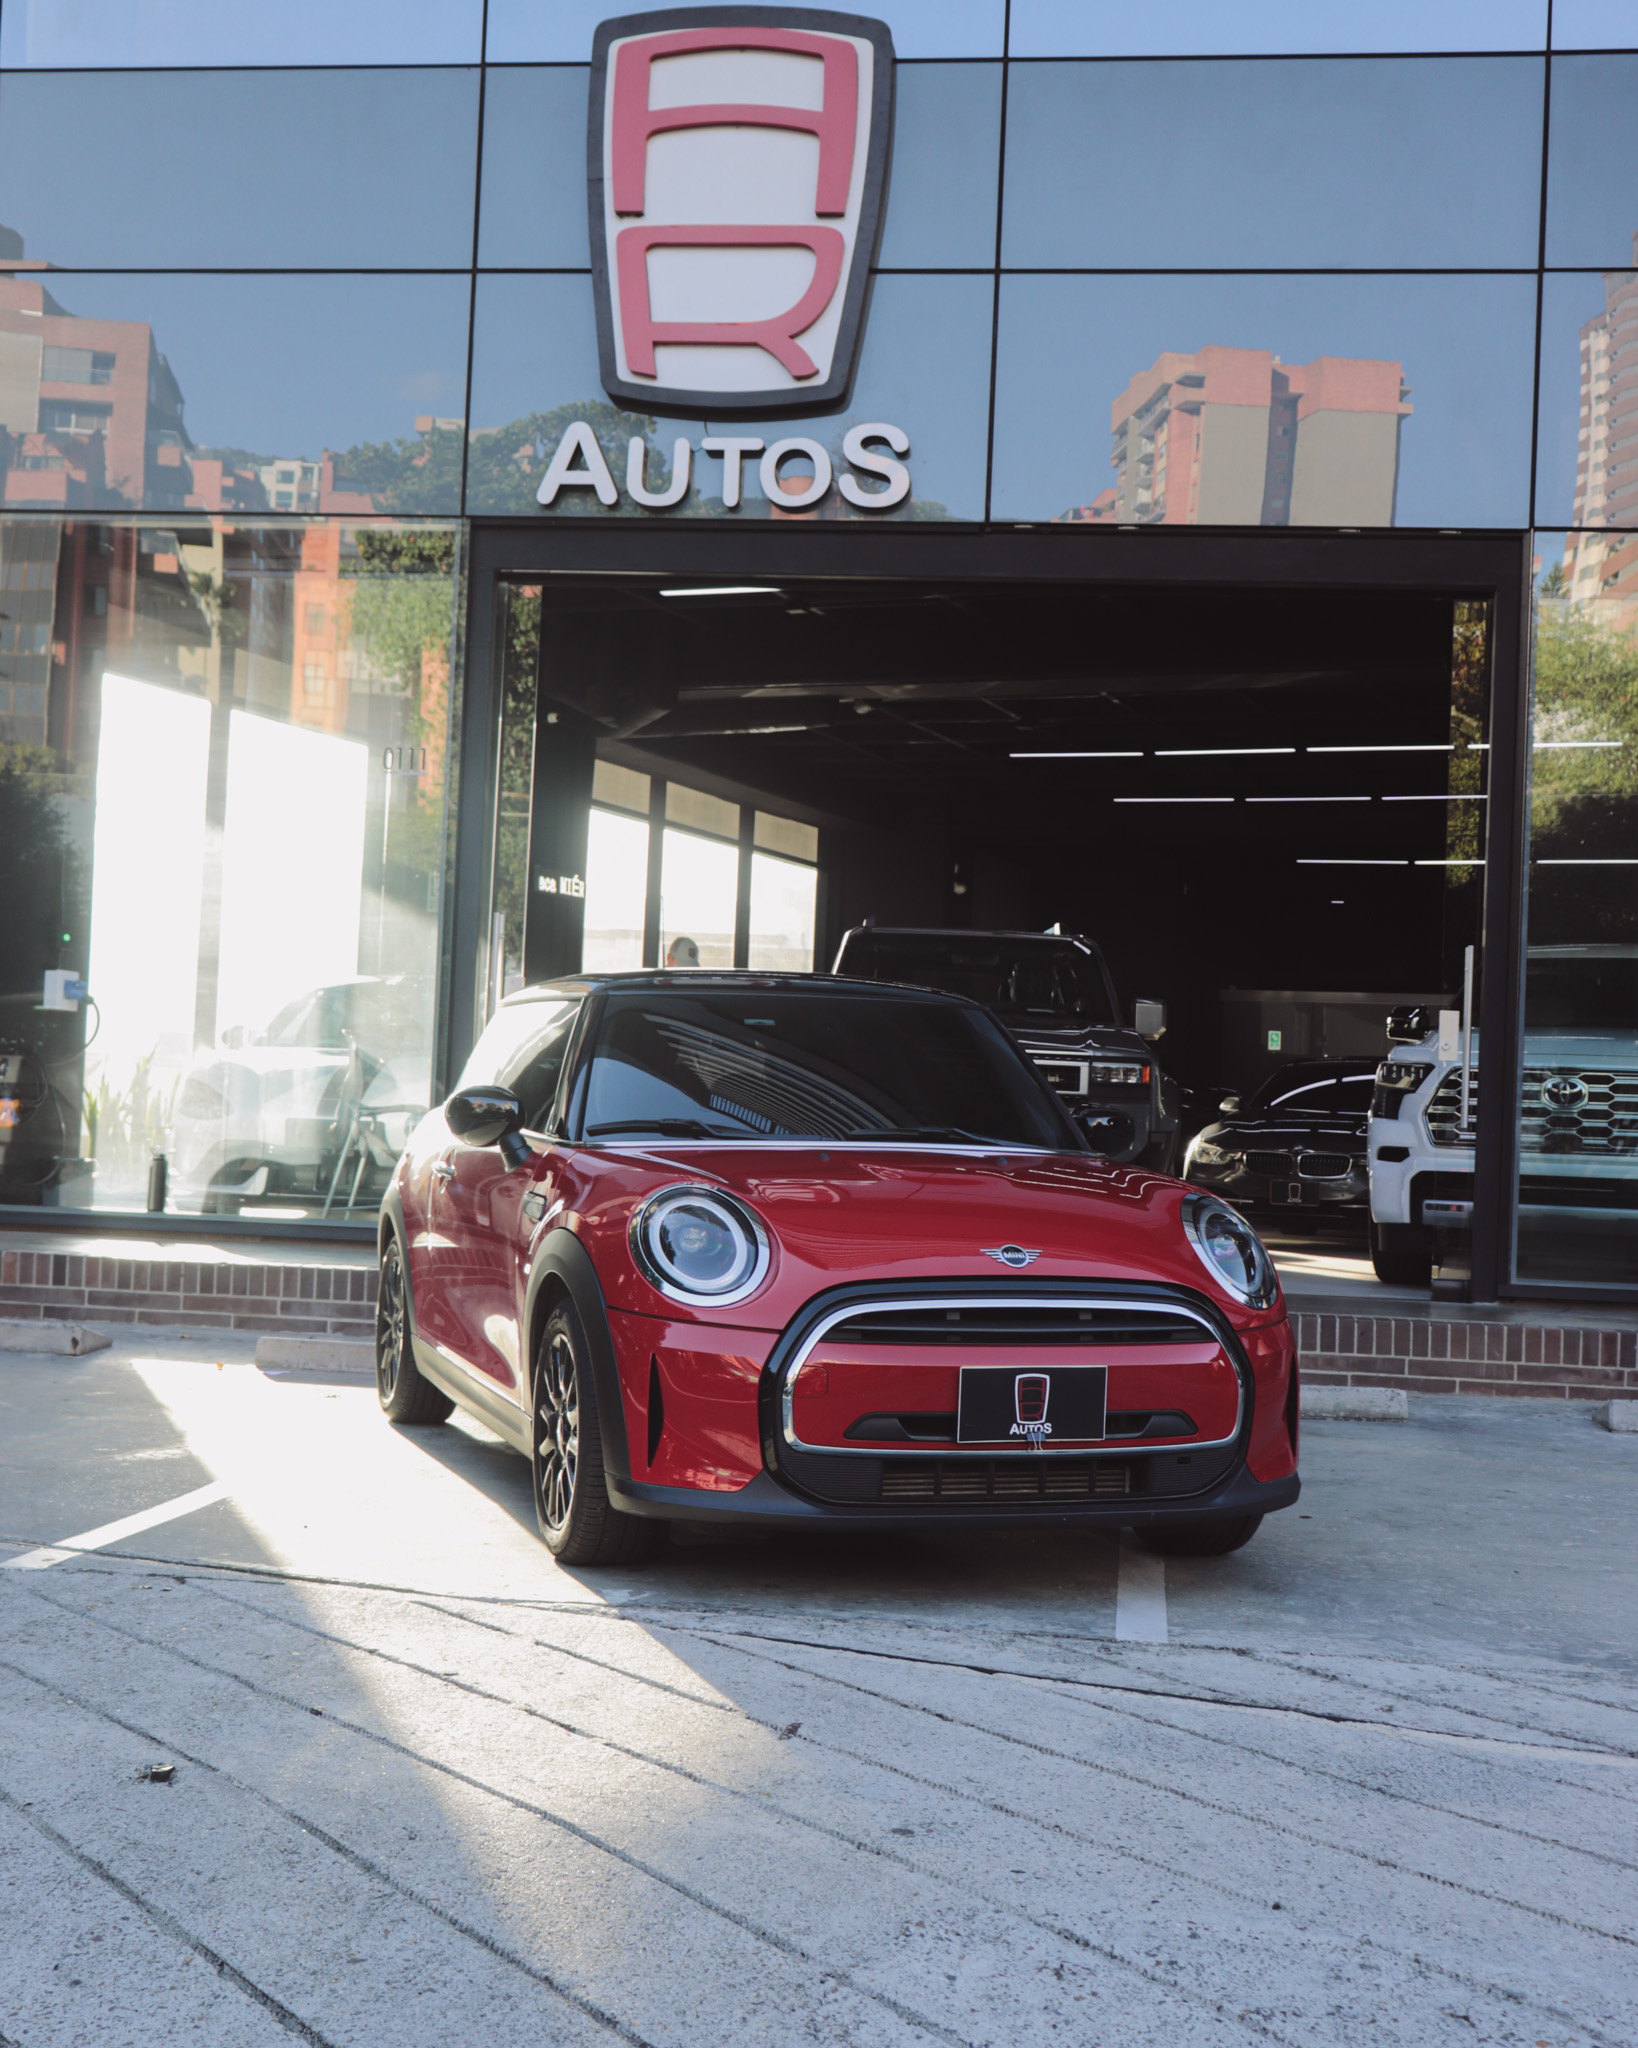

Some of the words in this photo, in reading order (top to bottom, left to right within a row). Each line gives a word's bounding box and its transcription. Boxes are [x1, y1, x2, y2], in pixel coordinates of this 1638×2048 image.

[536, 420, 911, 508] AUTOS
[1002, 1251, 1026, 1259] MINI
[1009, 1423, 1053, 1435] AUTOS
